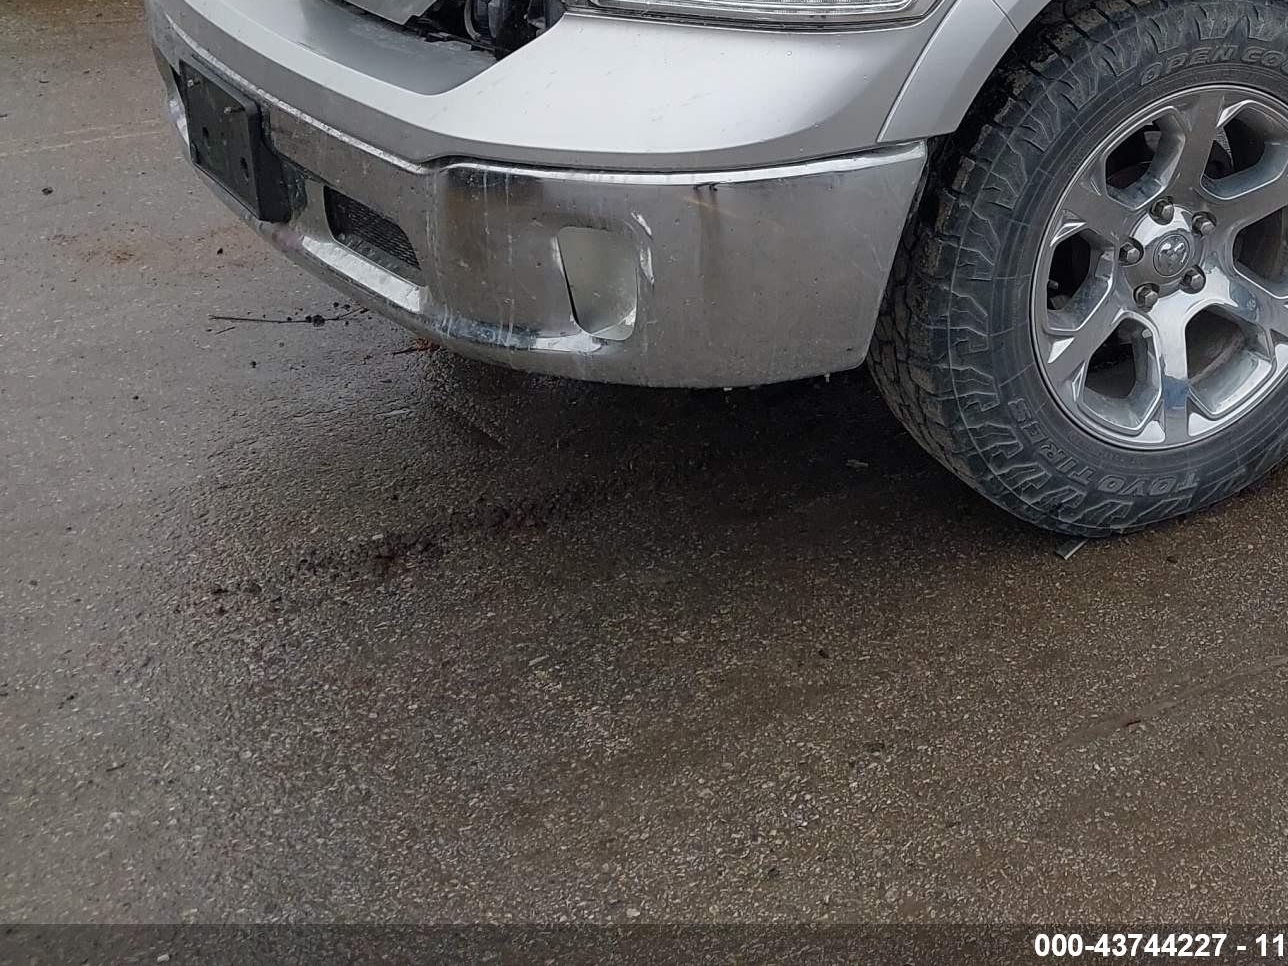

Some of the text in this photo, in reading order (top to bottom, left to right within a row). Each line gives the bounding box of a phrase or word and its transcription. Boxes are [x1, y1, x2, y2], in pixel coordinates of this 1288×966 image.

[1140, 43, 1239, 86] OPEN
[1007, 397, 1201, 497] TOYO TIRES
